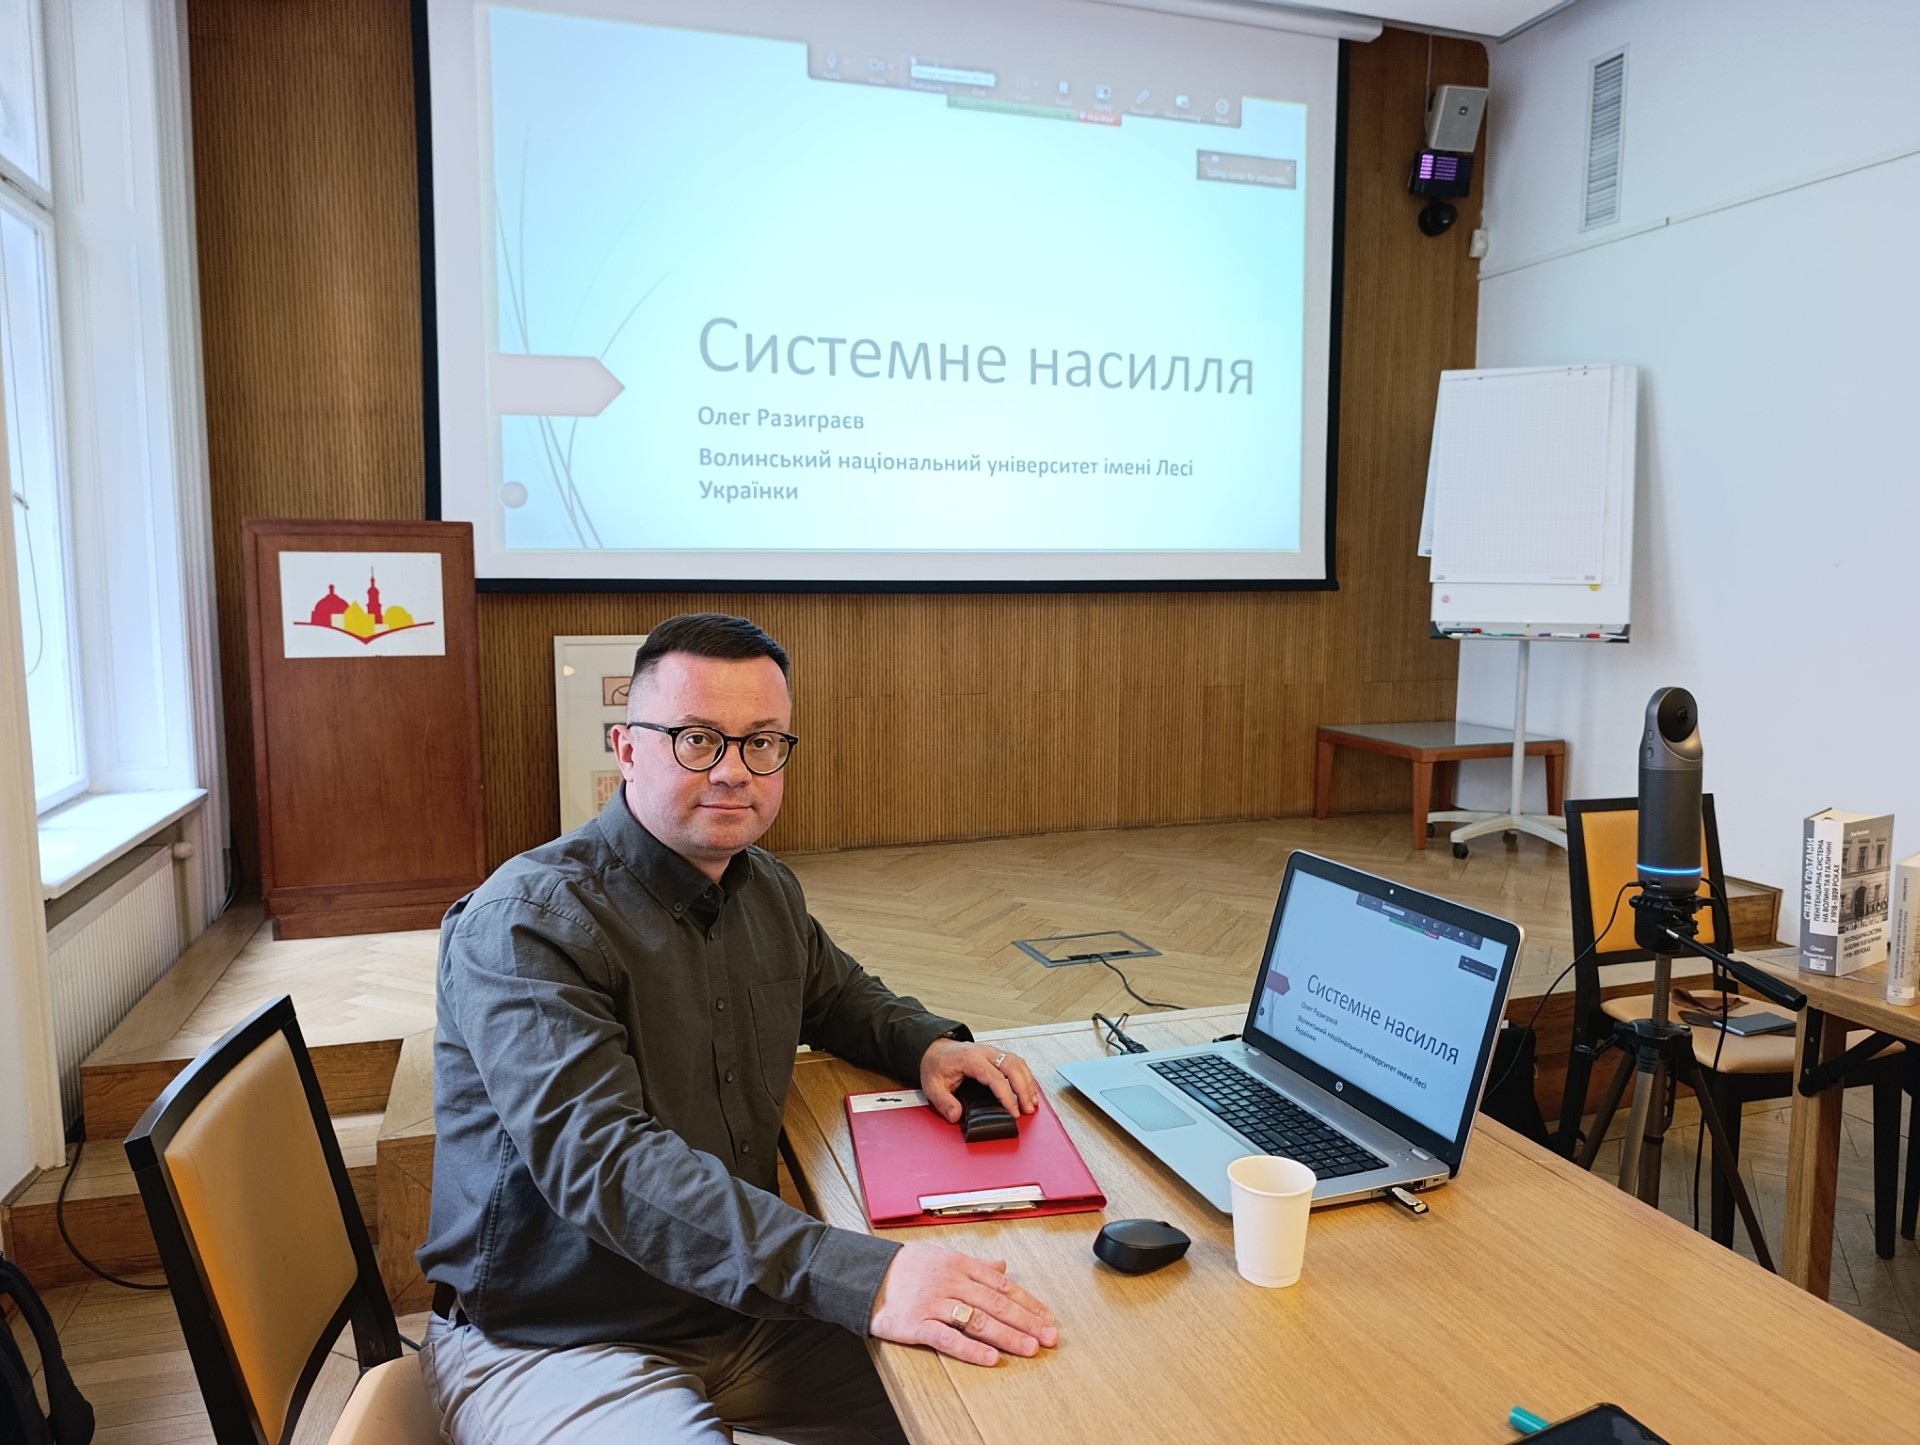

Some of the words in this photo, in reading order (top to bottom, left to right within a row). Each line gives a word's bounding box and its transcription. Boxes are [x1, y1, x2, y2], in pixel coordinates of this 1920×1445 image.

[697, 316, 1007, 385] Системне
[1028, 346, 1254, 396] насилля
[697, 405, 751, 429] Олег
[756, 408, 865, 434] Разиграєв
[698, 446, 832, 470] Волинський
[837, 451, 981, 473] національний
[986, 456, 1098, 477] університет
[1103, 457, 1151, 476] імені
[1155, 459, 1194, 477] Лесі
[698, 479, 799, 502] Українки
[1816, 839, 1825, 871] СИСТЕМА
[1825, 841, 1833, 873] ГАЛИЧИНІ
[1823, 879, 1830, 887] ТА
[1832, 864, 1840, 886] РОКАХ
[1804, 883, 1813, 896] ЗА
[1813, 872, 1823, 922] ПЕНІТЕНЦІАРНА
[1822, 888, 1830, 912] ВОЛИНІ
[1803, 896, 1812, 920] СВІТ
[1822, 913, 1829, 923] НА
[1300, 1001, 1313, 1013] Олег
[1307, 974, 1381, 1026] Системне
[1383, 1015, 1459, 1065] насилля
[1295, 1024, 1317, 1042] Українки
[1297, 1014, 1327, 1035] Волинський
[1327, 1031, 1364, 1055] національний
[1363, 1050, 1397, 1074] університет
[1397, 1069, 1413, 1082] імені
[1413, 1076, 1427, 1090] Лесі
